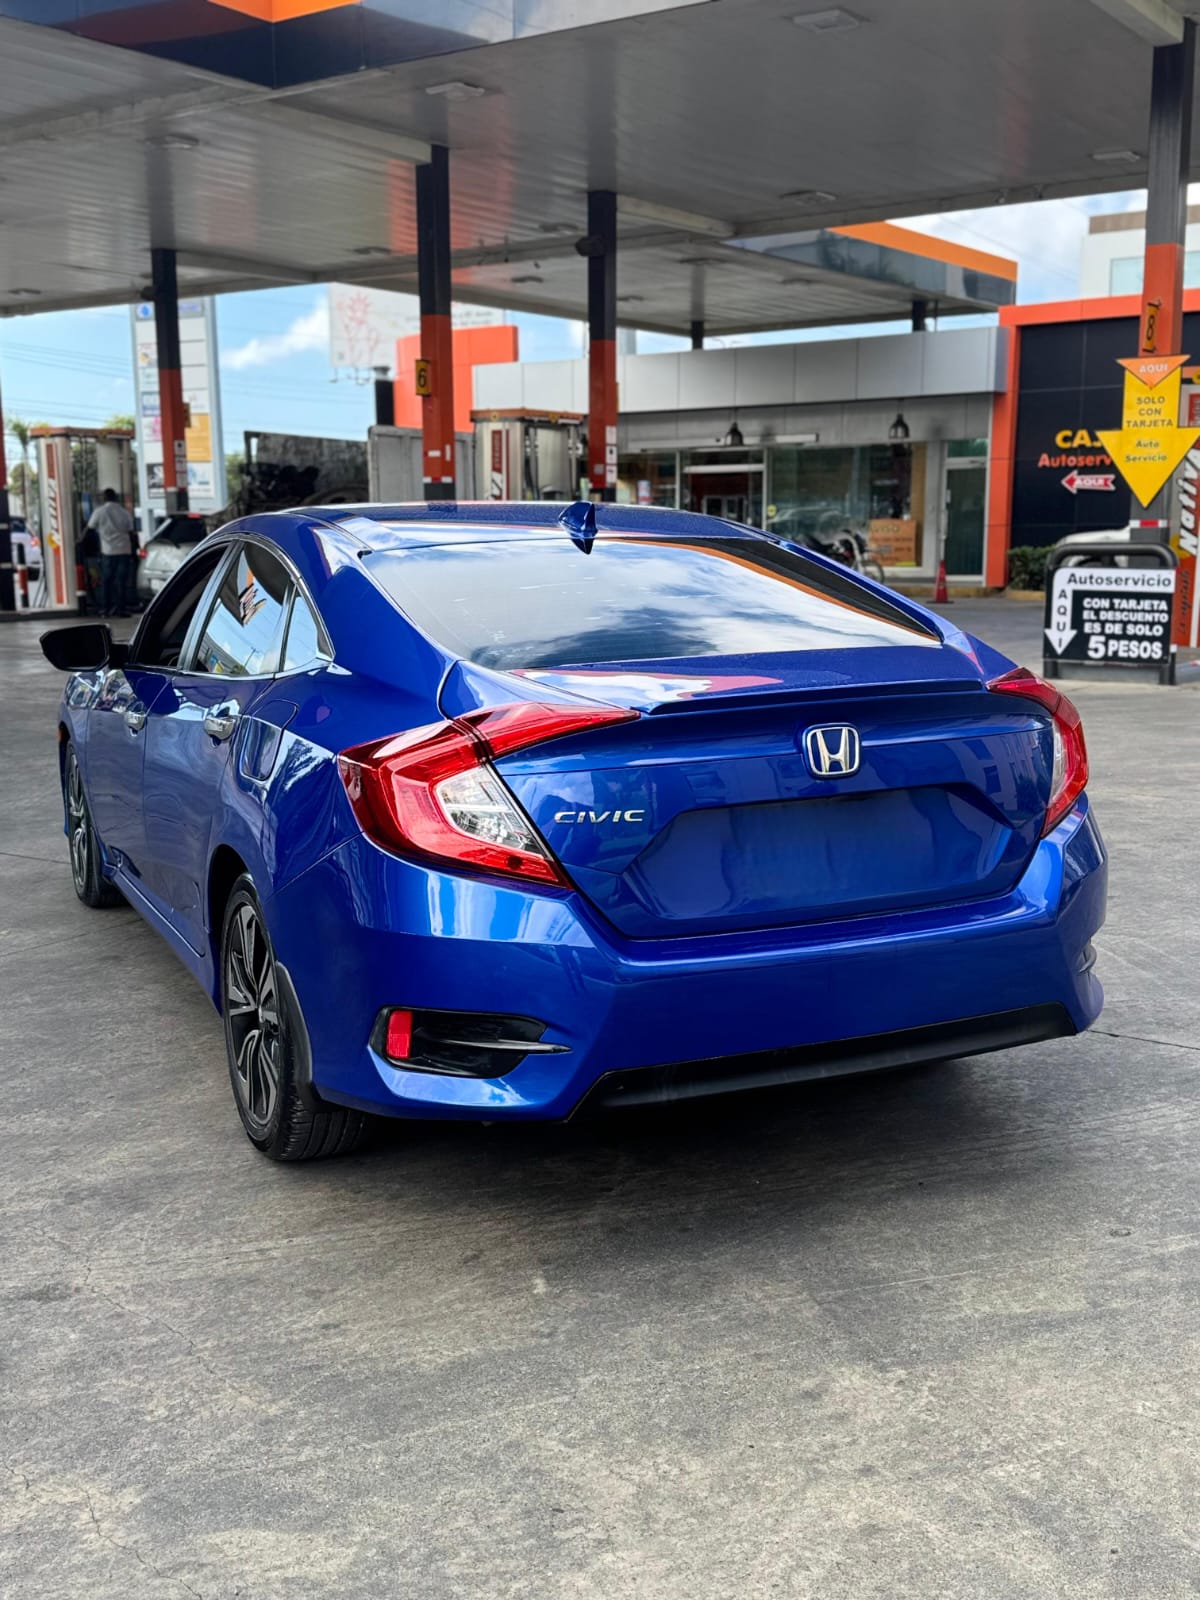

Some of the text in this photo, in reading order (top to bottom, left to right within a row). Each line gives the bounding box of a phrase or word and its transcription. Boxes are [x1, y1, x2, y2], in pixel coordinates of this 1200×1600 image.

[1146, 314, 1156, 341] 8
[1139, 362, 1169, 374] AQUI
[417, 367, 427, 388] 6
[1136, 396, 1166, 405] SOLO
[1138, 408, 1162, 416] CON
[1126, 419, 1174, 428] TARJETA
[1136, 440, 1160, 448] Auto
[1125, 453, 1168, 463] Servicio
[1067, 573, 1172, 588] Autoservicio
[1083, 598, 1169, 611] CON TARJETA
[1083, 610, 1169, 623] EL DESCUENTO
[1084, 622, 1164, 637] ES DE SOLO
[1087, 635, 1163, 660] 5 PESOS
[554, 809, 645, 824] CIVIC
